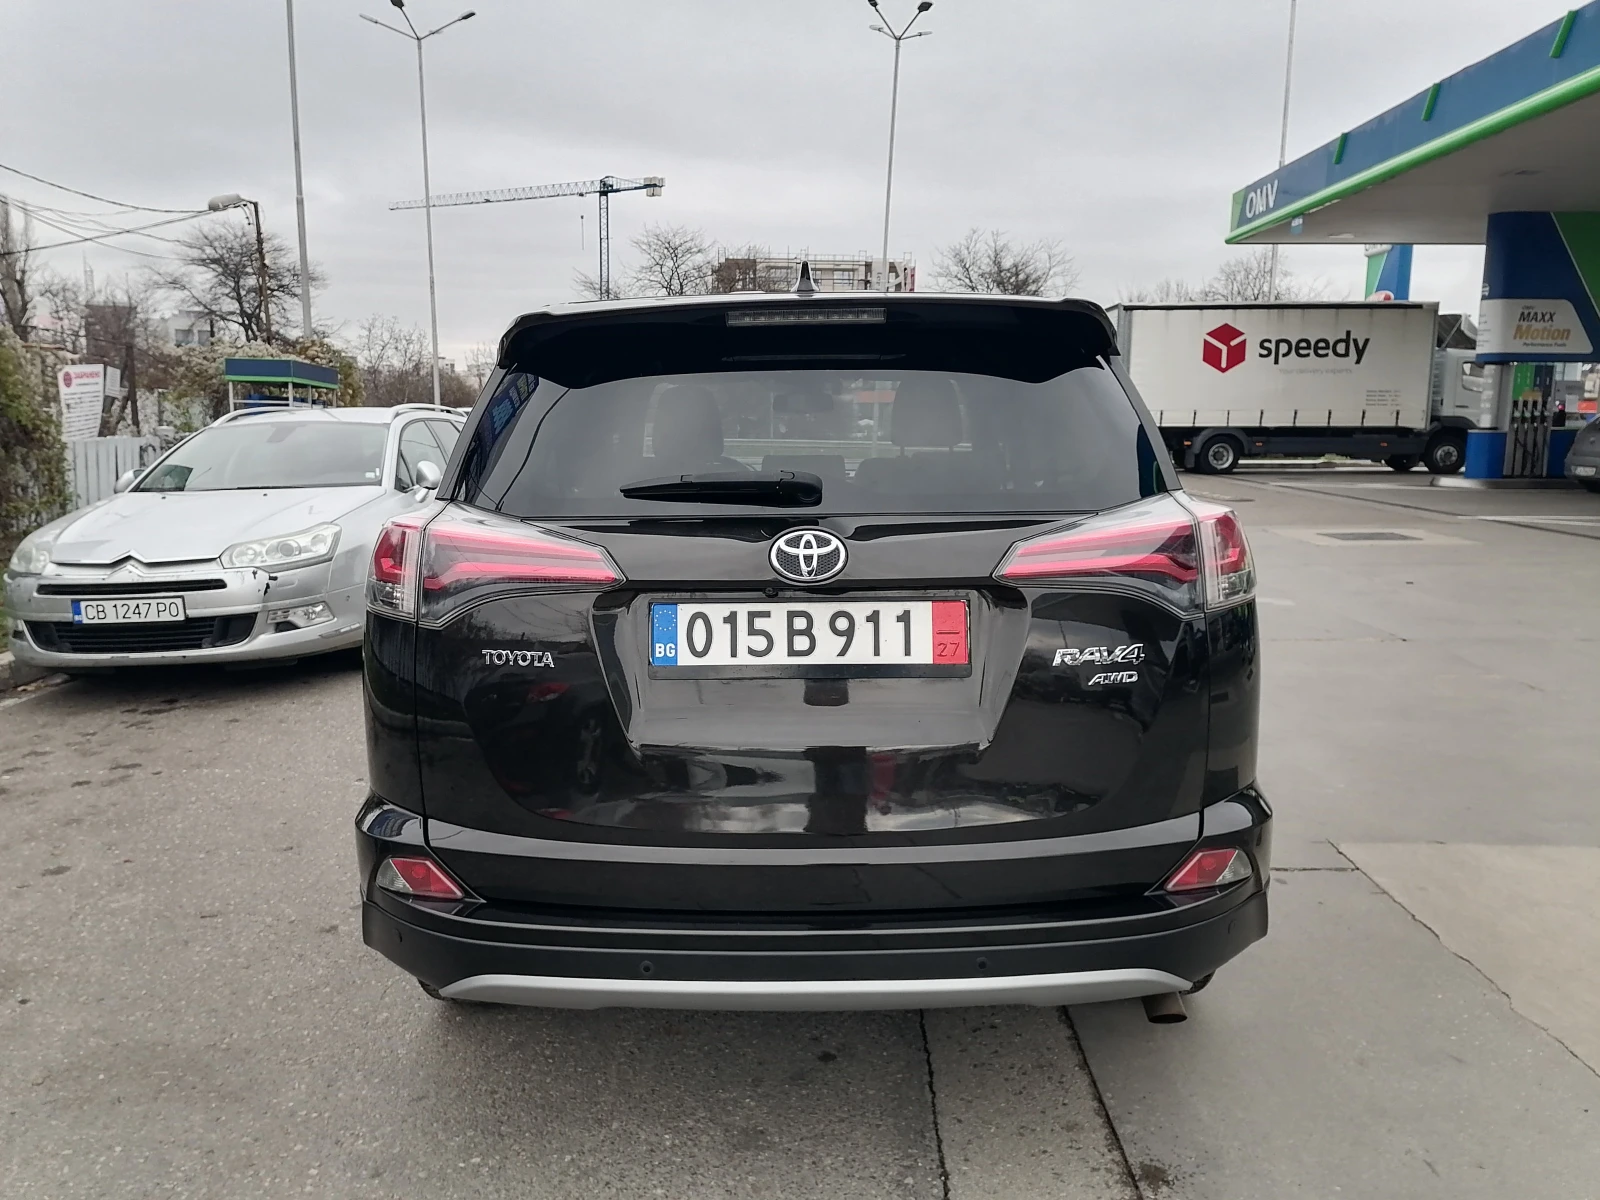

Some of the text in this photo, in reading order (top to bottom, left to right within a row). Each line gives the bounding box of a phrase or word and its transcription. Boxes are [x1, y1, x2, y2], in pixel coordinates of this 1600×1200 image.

[1245, 179, 1279, 219] OMV
[1518, 311, 1556, 323] MAXX
[1512, 323, 1571, 341] Motion
[1258, 330, 1370, 365] speedy
[112, 603, 152, 619] 1247
[655, 609, 960, 658] BG 015B911 27
[481, 649, 555, 668] TOYOTA
[1052, 643, 1146, 666] RAV4
[1087, 671, 1139, 686] AWD
